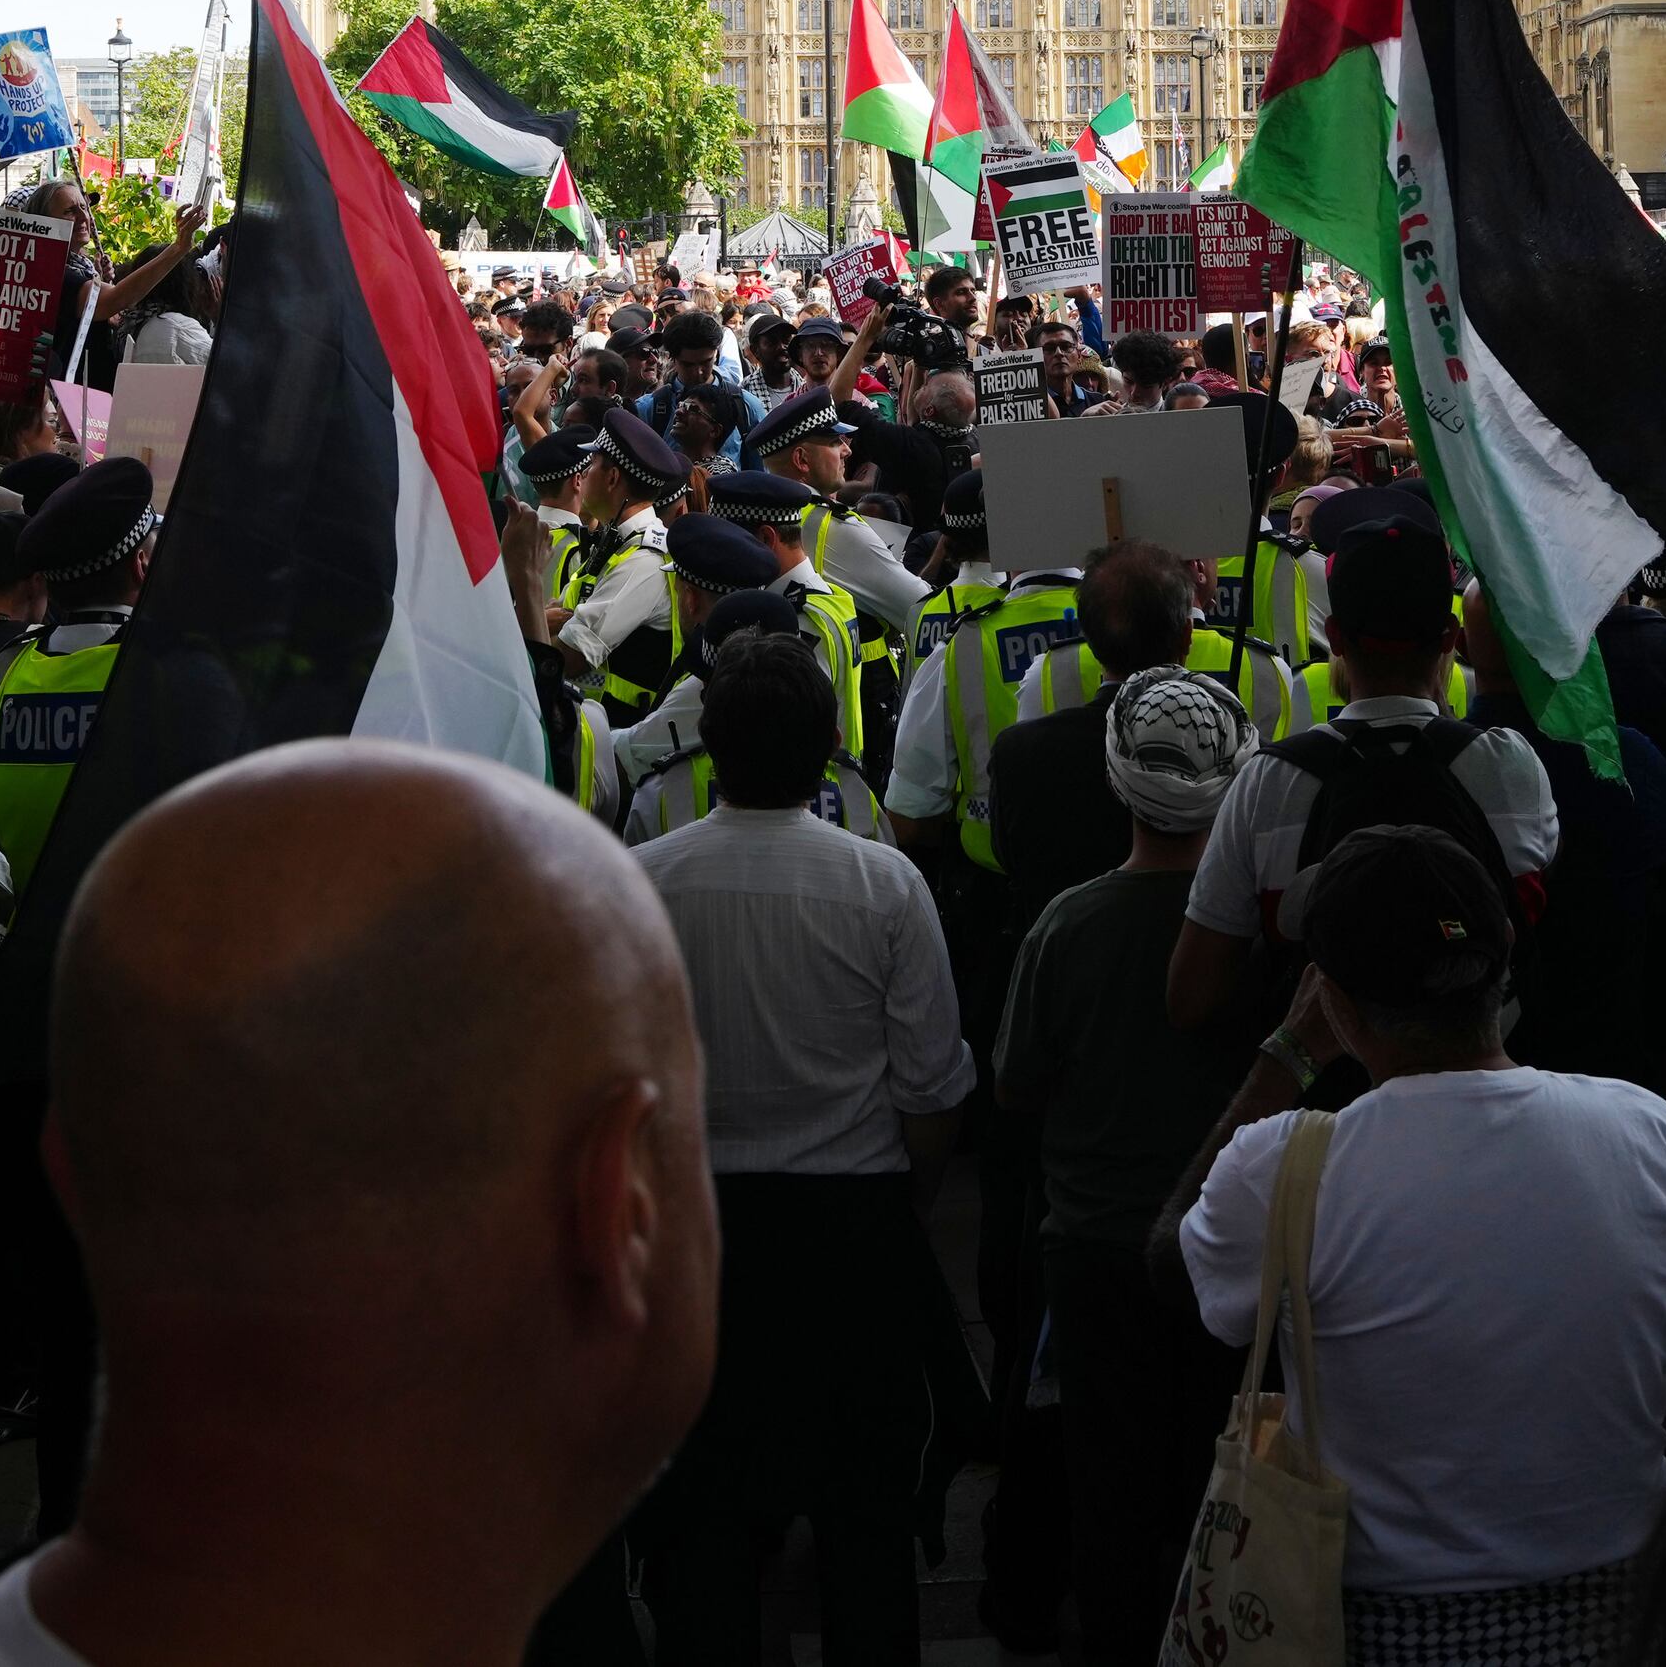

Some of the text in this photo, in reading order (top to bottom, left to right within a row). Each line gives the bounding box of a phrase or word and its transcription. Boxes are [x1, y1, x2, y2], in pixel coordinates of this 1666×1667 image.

[32, 75, 44, 95] UP
[8, 93, 46, 114] PROJECT
[984, 163, 1013, 174] Palestine
[1013, 158, 1044, 169] Solidarity
[1044, 154, 1076, 165] Campaign
[1122, 203, 1139, 212] Stop
[1139, 203, 1152, 211] the
[1152, 202, 1167, 211] War
[1217, 205, 1238, 221] NOT
[1241, 205, 1249, 220] A
[996, 207, 1094, 254] FREE
[1110, 213, 1192, 236] DROP THE BA
[1197, 221, 1246, 237] CRIME TO
[24, 238, 37, 262] A
[1003, 240, 1097, 270] PALESTINE
[1110, 236, 1173, 264] DEFEND
[1199, 238, 1217, 253] ACT
[1220, 236, 1263, 252] AGAINST
[476, 264, 557, 273] PICE
[847, 254, 865, 269] NOT
[866, 249, 874, 260] A
[1008, 257, 1099, 281] END ISRAELI OCCUPATION
[1200, 253, 1251, 268] GENOCIDE
[4, 259, 27, 283] TO
[833, 262, 874, 287] CRIME TO
[1110, 264, 1197, 299] RIGHT TO
[836, 283, 853, 298] ACT
[839, 288, 865, 308] GENO
[1110, 299, 1198, 334] PROTEST
[980, 368, 1039, 395] FREEDOM
[1003, 391, 1014, 402] for
[980, 398, 1045, 426] PALESTINE
